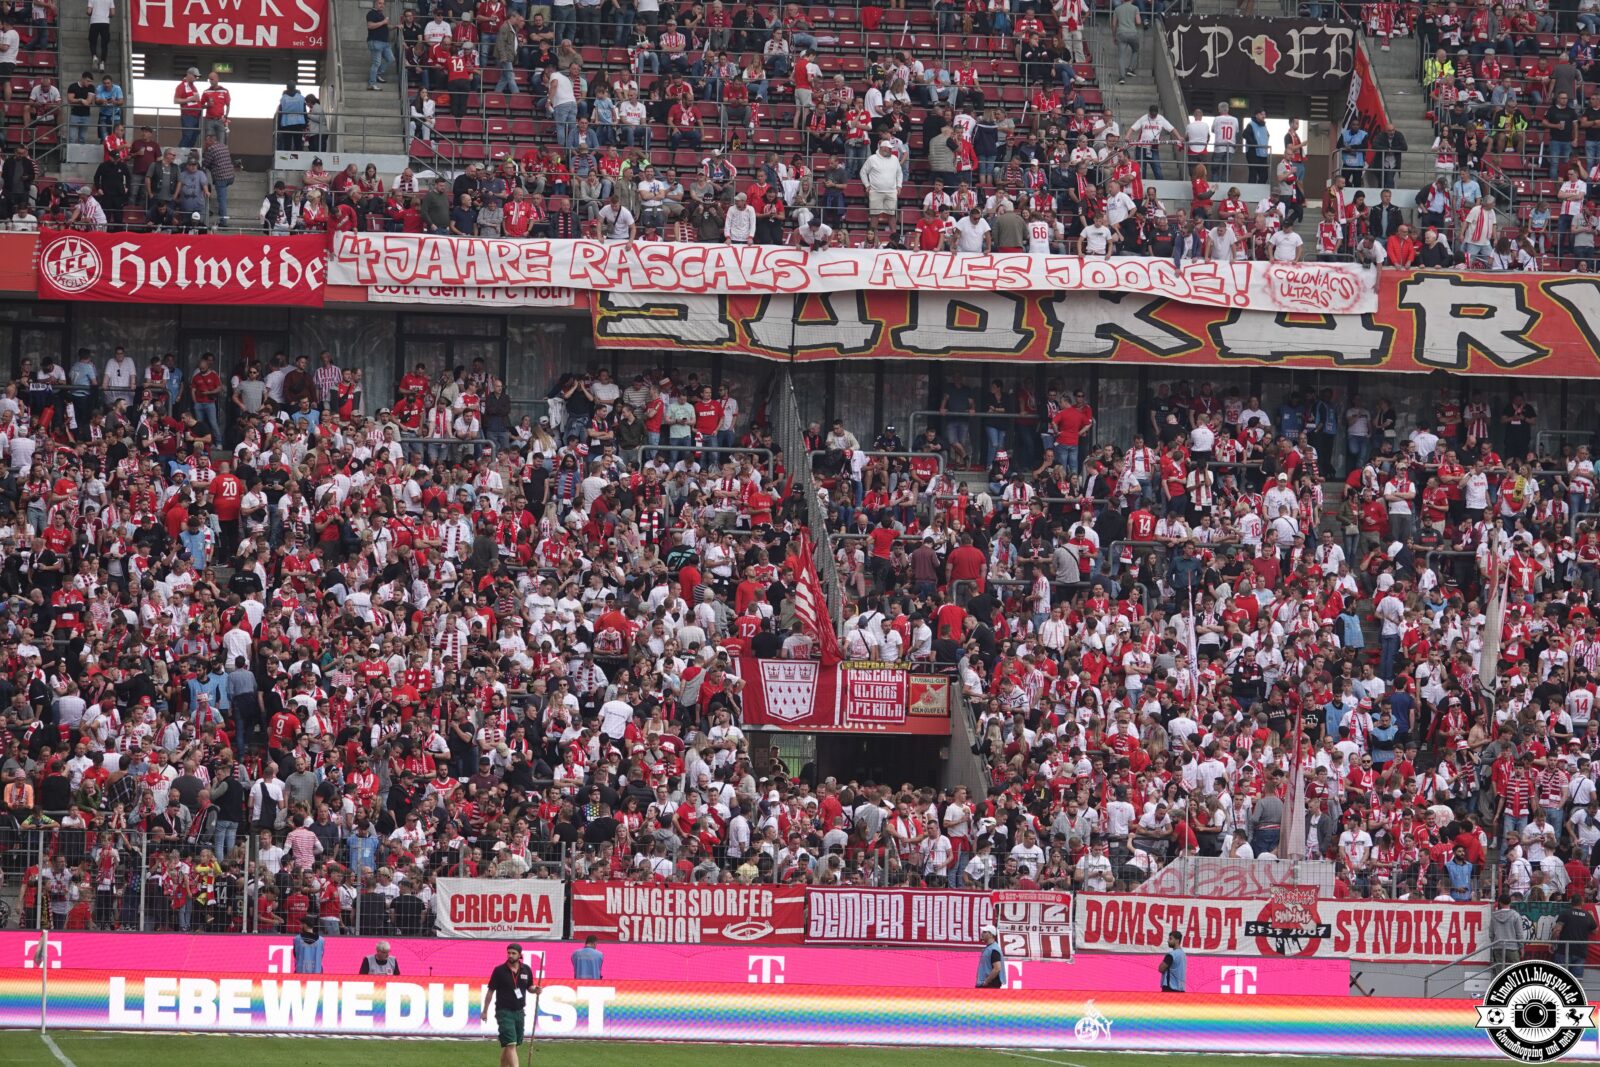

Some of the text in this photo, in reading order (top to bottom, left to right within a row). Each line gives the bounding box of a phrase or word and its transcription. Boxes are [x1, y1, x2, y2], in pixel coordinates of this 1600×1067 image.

[188, 18, 278, 47] KÖLN
[451, 58, 465, 72] 14
[1221, 126, 1233, 141] 10
[1032, 227, 1047, 240] 66
[111, 241, 326, 295] Holweide
[339, 234, 380, 284] 4
[384, 236, 552, 286] JAHRE
[570, 241, 810, 292] RASCALS
[868, 252, 1032, 290] ALLES
[1280, 283, 1332, 308] ULTRAS
[222, 481, 237, 497] 20
[1139, 518, 1151, 534] 14
[741, 623, 756, 638] 12
[850, 669, 903, 682] RASCALS
[854, 684, 897, 699] ULTRAS
[1574, 698, 1588, 713] 14
[277, 719, 285, 734] 9
[214, 886, 227, 902] 14
[605, 882, 773, 917] MÜNGERSDORFER
[449, 893, 554, 925] CRICCAA
[809, 892, 905, 942] SEMPER
[490, 924, 513, 933] KÖLN
[618, 916, 701, 944] STADION
[1084, 900, 1482, 956] DOMSTADT SYNDIKAT
[109, 976, 253, 1026] LEBE
[261, 979, 375, 1031] WIE
[385, 982, 470, 1032] DU
